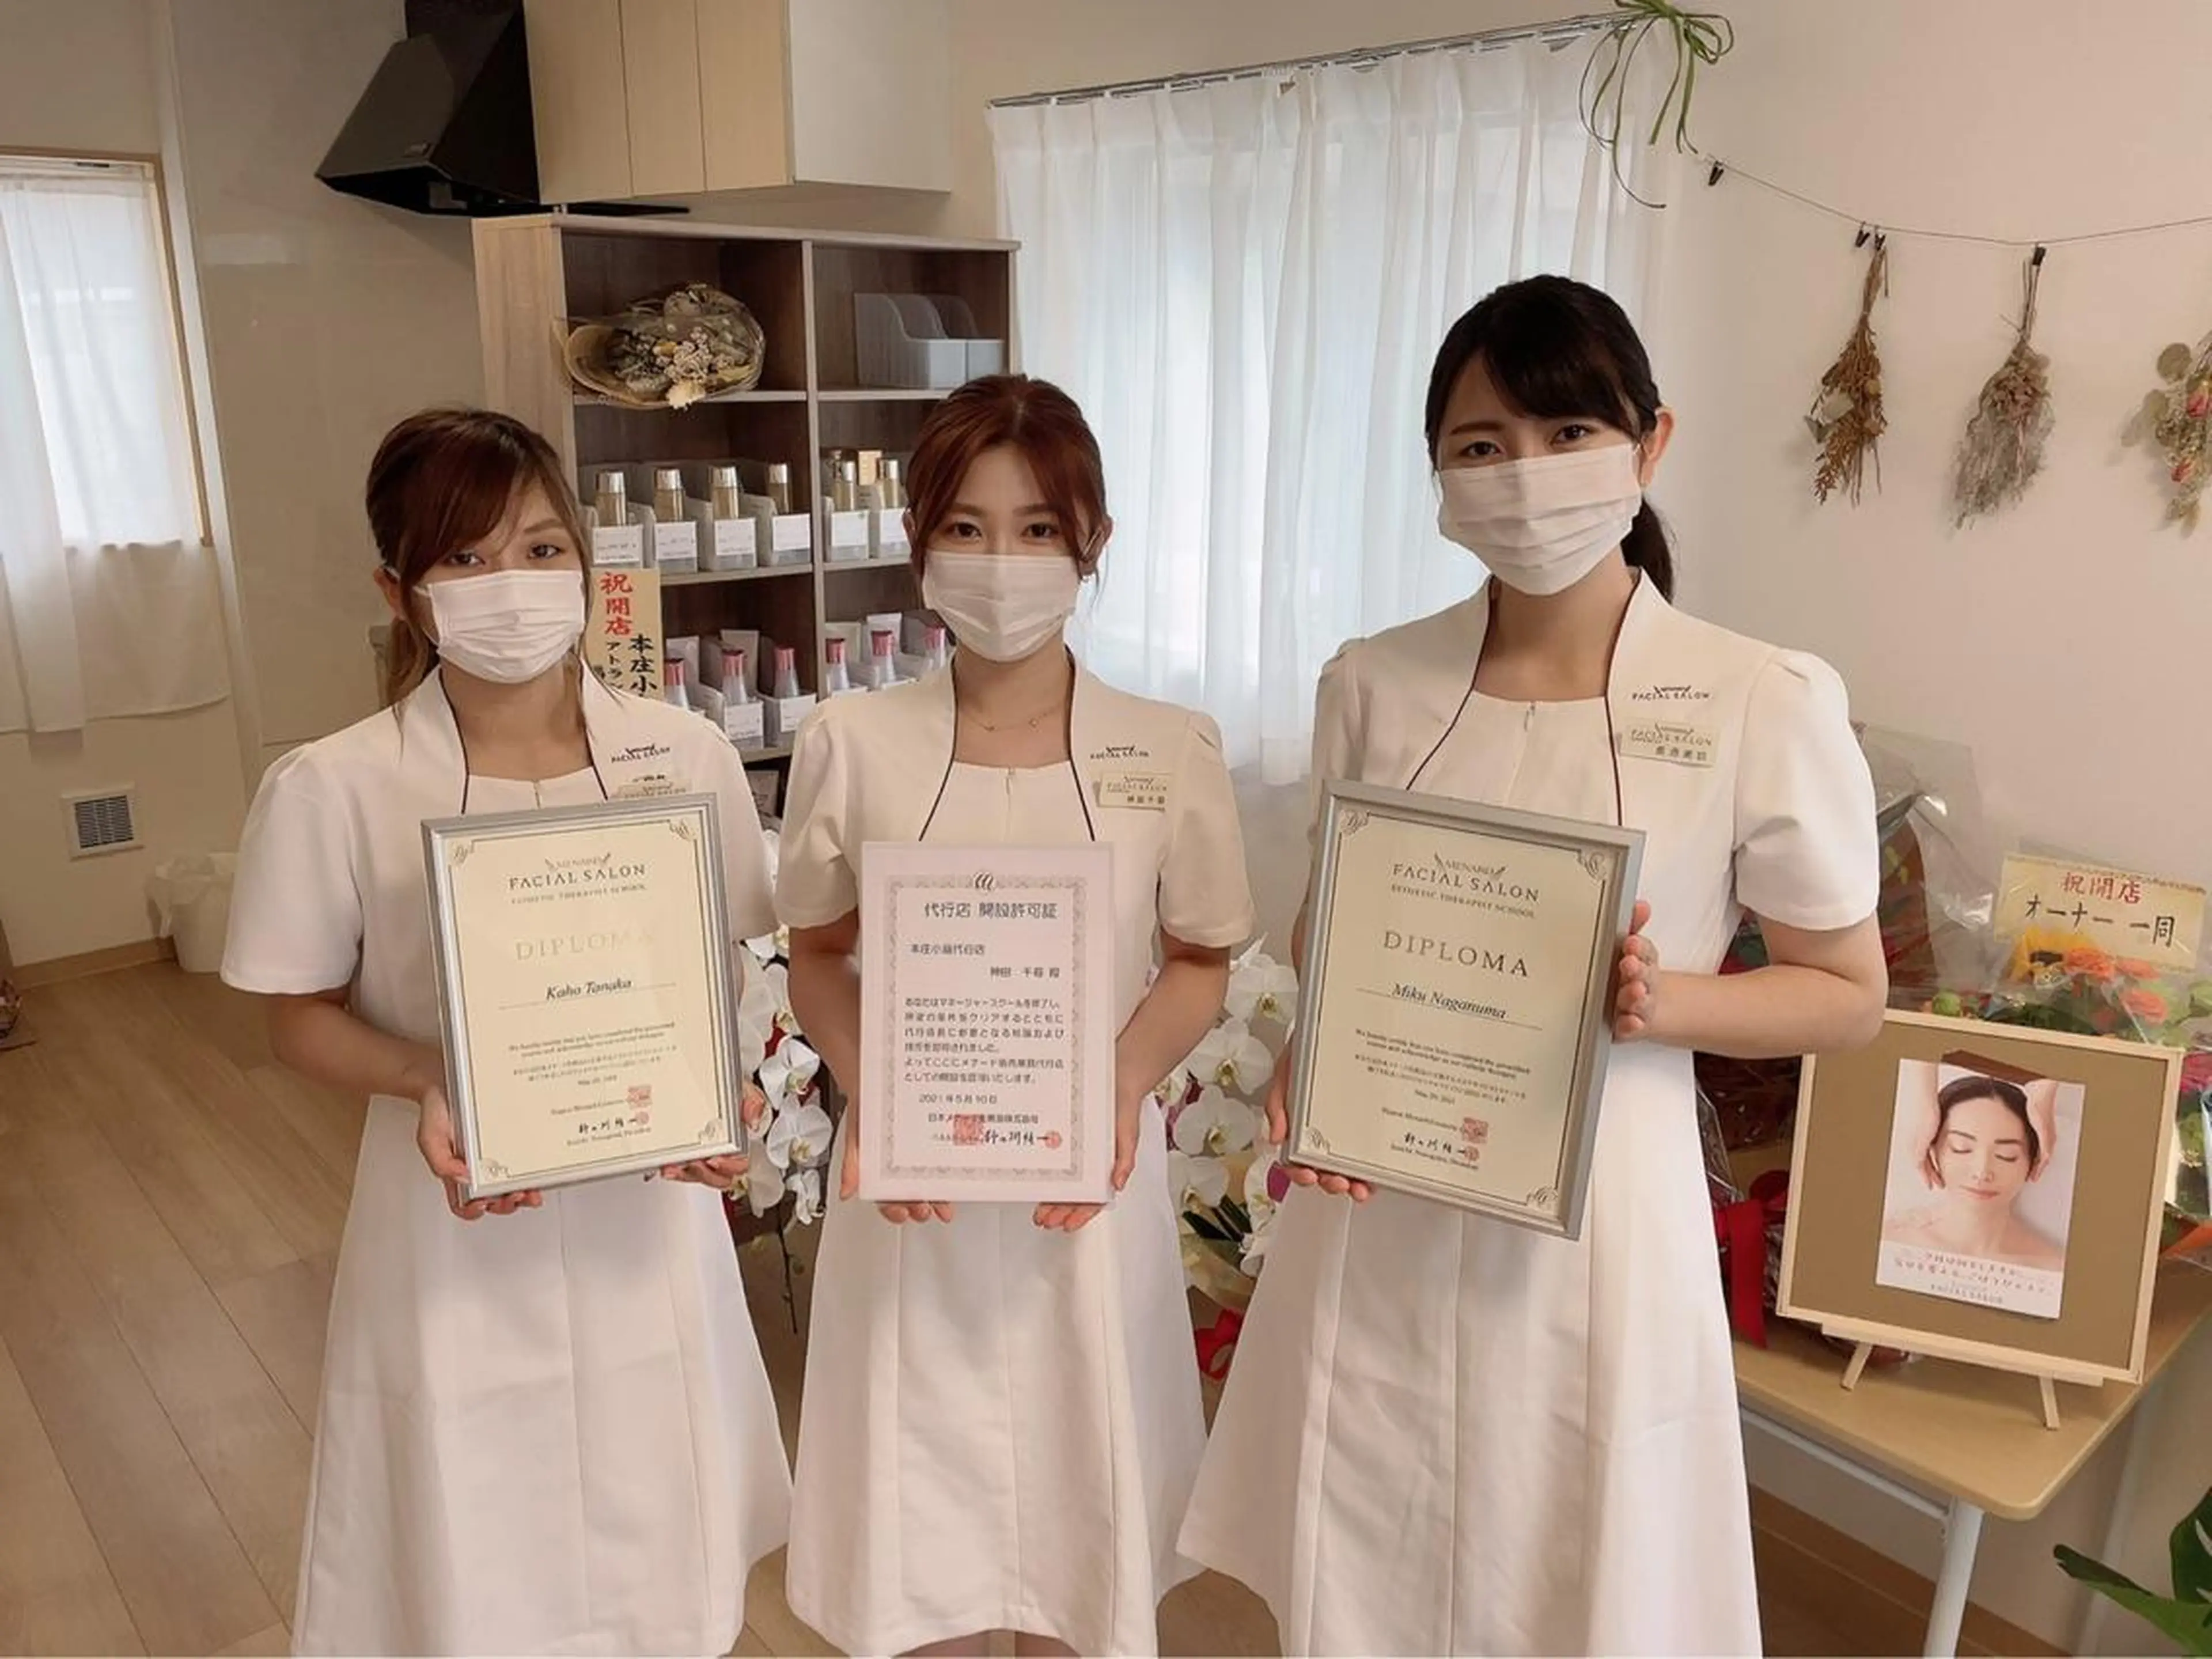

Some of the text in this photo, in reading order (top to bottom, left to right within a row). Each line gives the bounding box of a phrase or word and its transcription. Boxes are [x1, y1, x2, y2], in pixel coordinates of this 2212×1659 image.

[600, 571, 633, 635] 祝開店
[628, 634, 657, 697] 本庄小
[509, 864, 645, 890] FACIAL SALON
[1393, 864, 1539, 902] FACIAL SALON
[2063, 872, 2142, 904] 祝開店
[924, 902, 1058, 919] 代行店 開設許可証
[2025, 893, 2175, 948] オーナー 一同
[1384, 930, 1528, 977] DIPLOMA
[546, 978, 632, 1001] Kaho Tanaka
[1392, 983, 1506, 1018] Miku Naganuma
